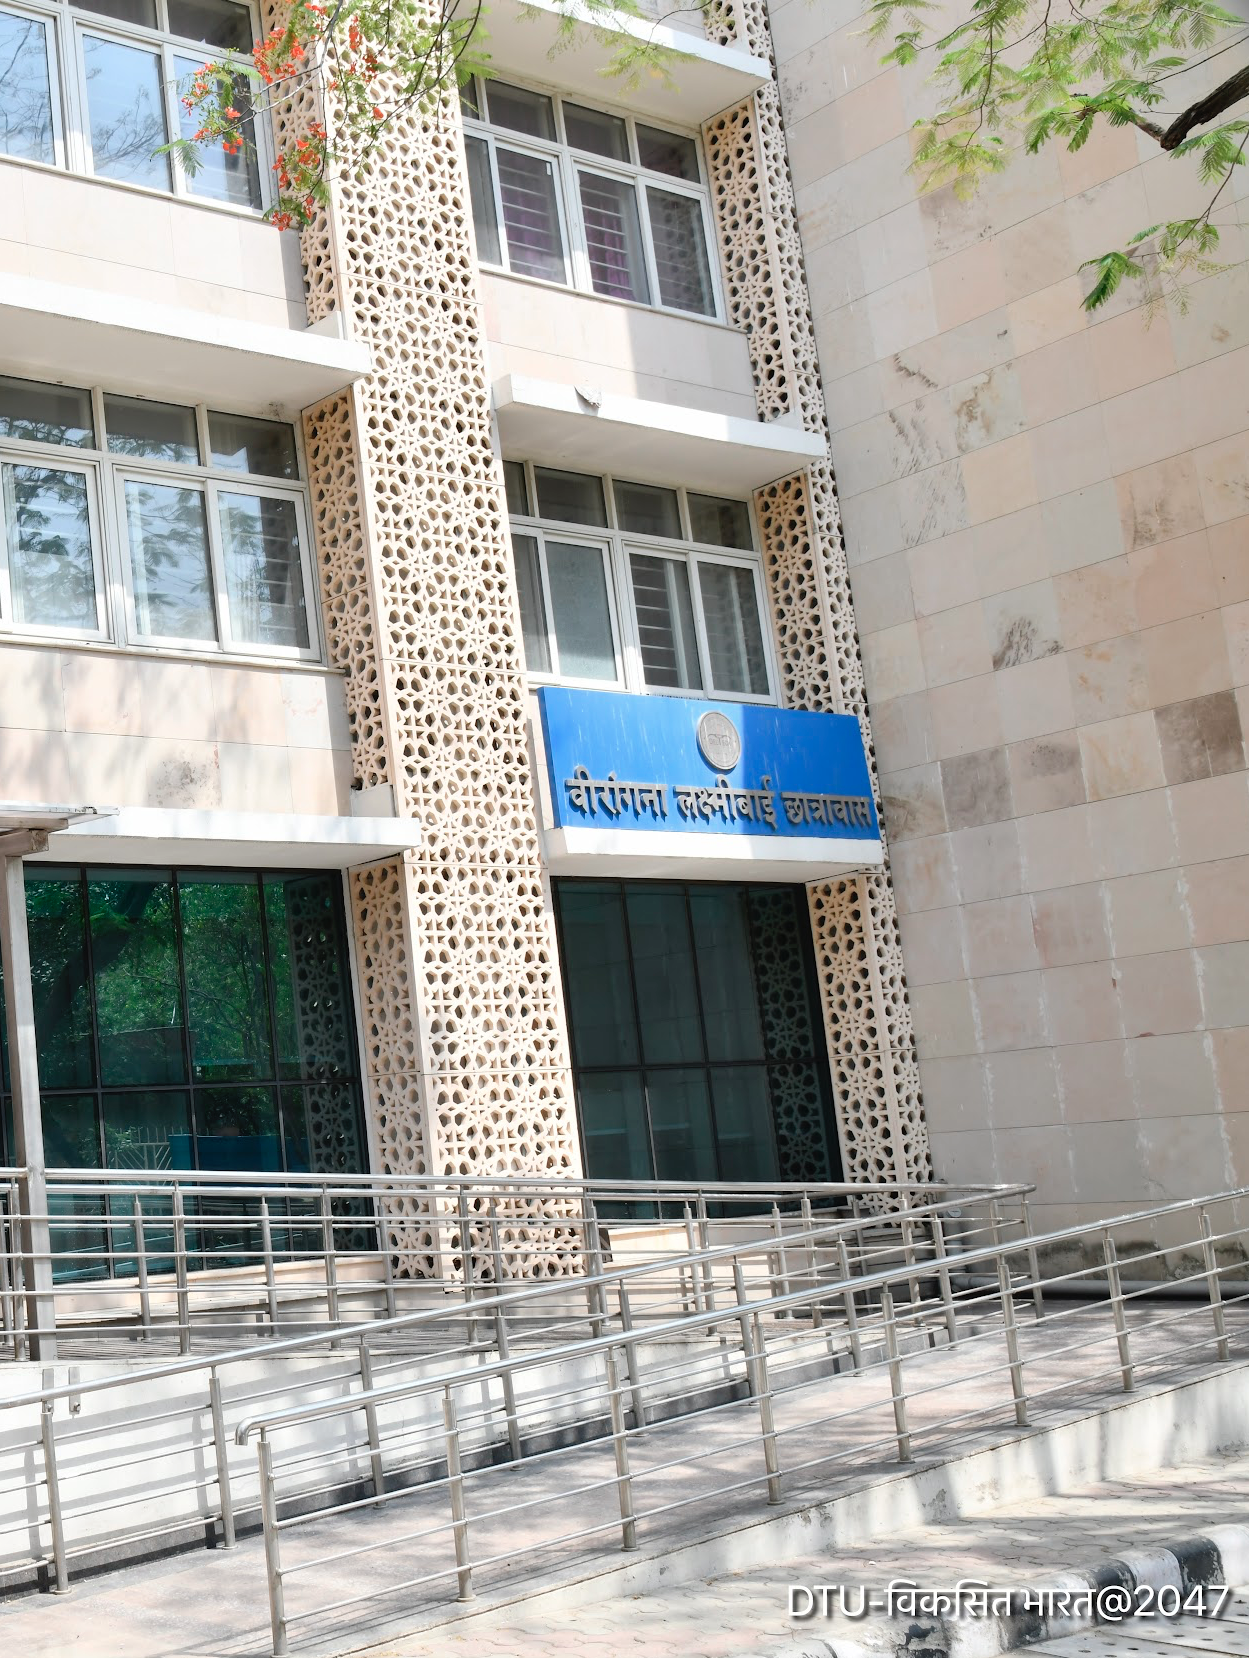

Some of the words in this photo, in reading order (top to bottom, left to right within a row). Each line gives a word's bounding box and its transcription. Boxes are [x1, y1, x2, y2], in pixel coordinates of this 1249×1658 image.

[565, 766, 668, 817] वीरांगना
[673, 774, 778, 829] लक्ष्मीबाई
[781, 793, 873, 826] छात्रावास
